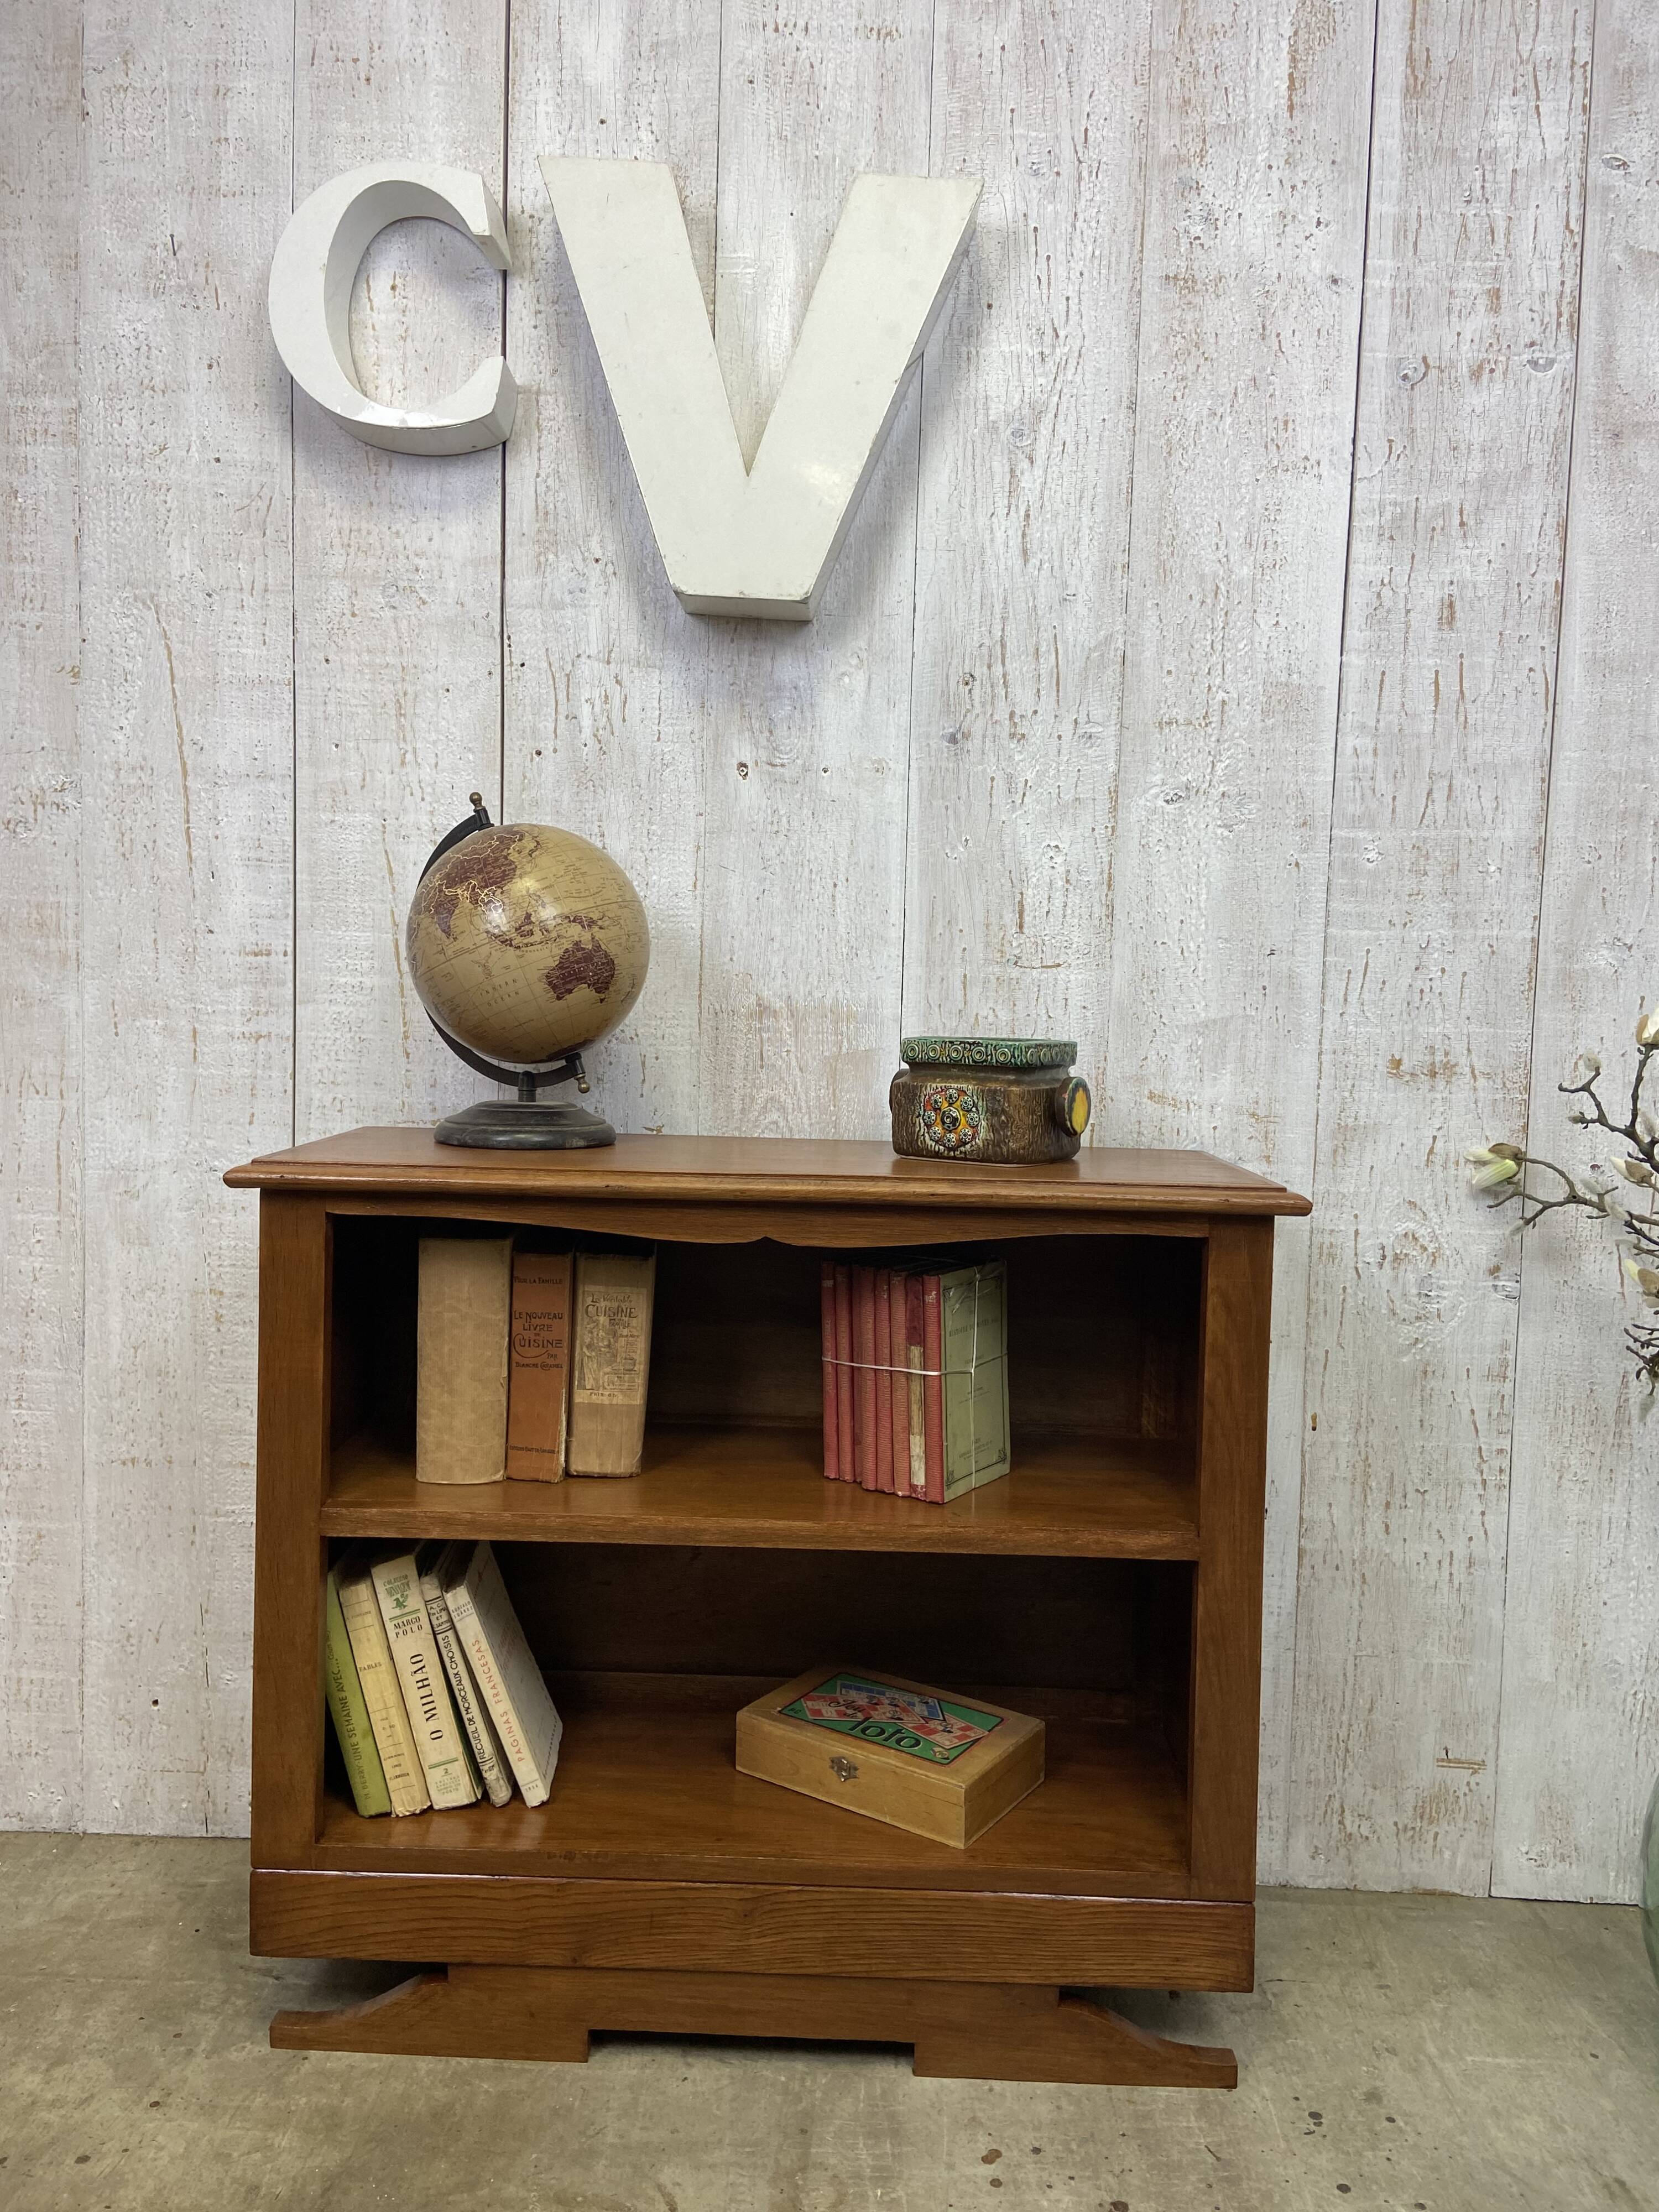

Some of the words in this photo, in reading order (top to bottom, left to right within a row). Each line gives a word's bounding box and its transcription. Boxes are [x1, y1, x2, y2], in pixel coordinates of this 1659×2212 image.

[487, 990, 519, 1006] OCEAN
[514, 1310, 523, 1319] LE
[525, 1312, 563, 1323] NOUVEAU
[585, 1304, 639, 1318] CUISINE
[523, 1322, 553, 1332] LIVRE
[513, 1333, 563, 1358] CUISINE
[393, 1615, 421, 1630] MARCO
[395, 1624, 423, 1639] POLO
[442, 1635, 458, 1670] CHOISIS
[358, 1662, 383, 1672] FABLES
[472, 1640, 503, 1704] FRANCESAS
[409, 1653, 440, 1723] MILHÃO
[453, 1672, 472, 1715] MORCEAUX
[338, 1694, 357, 1740] SEMAINE
[467, 1716, 476, 1726] DE
[429, 1729, 444, 1741] O
[848, 1716, 922, 1749] loto
[471, 1726, 487, 1760] RECUEIL
